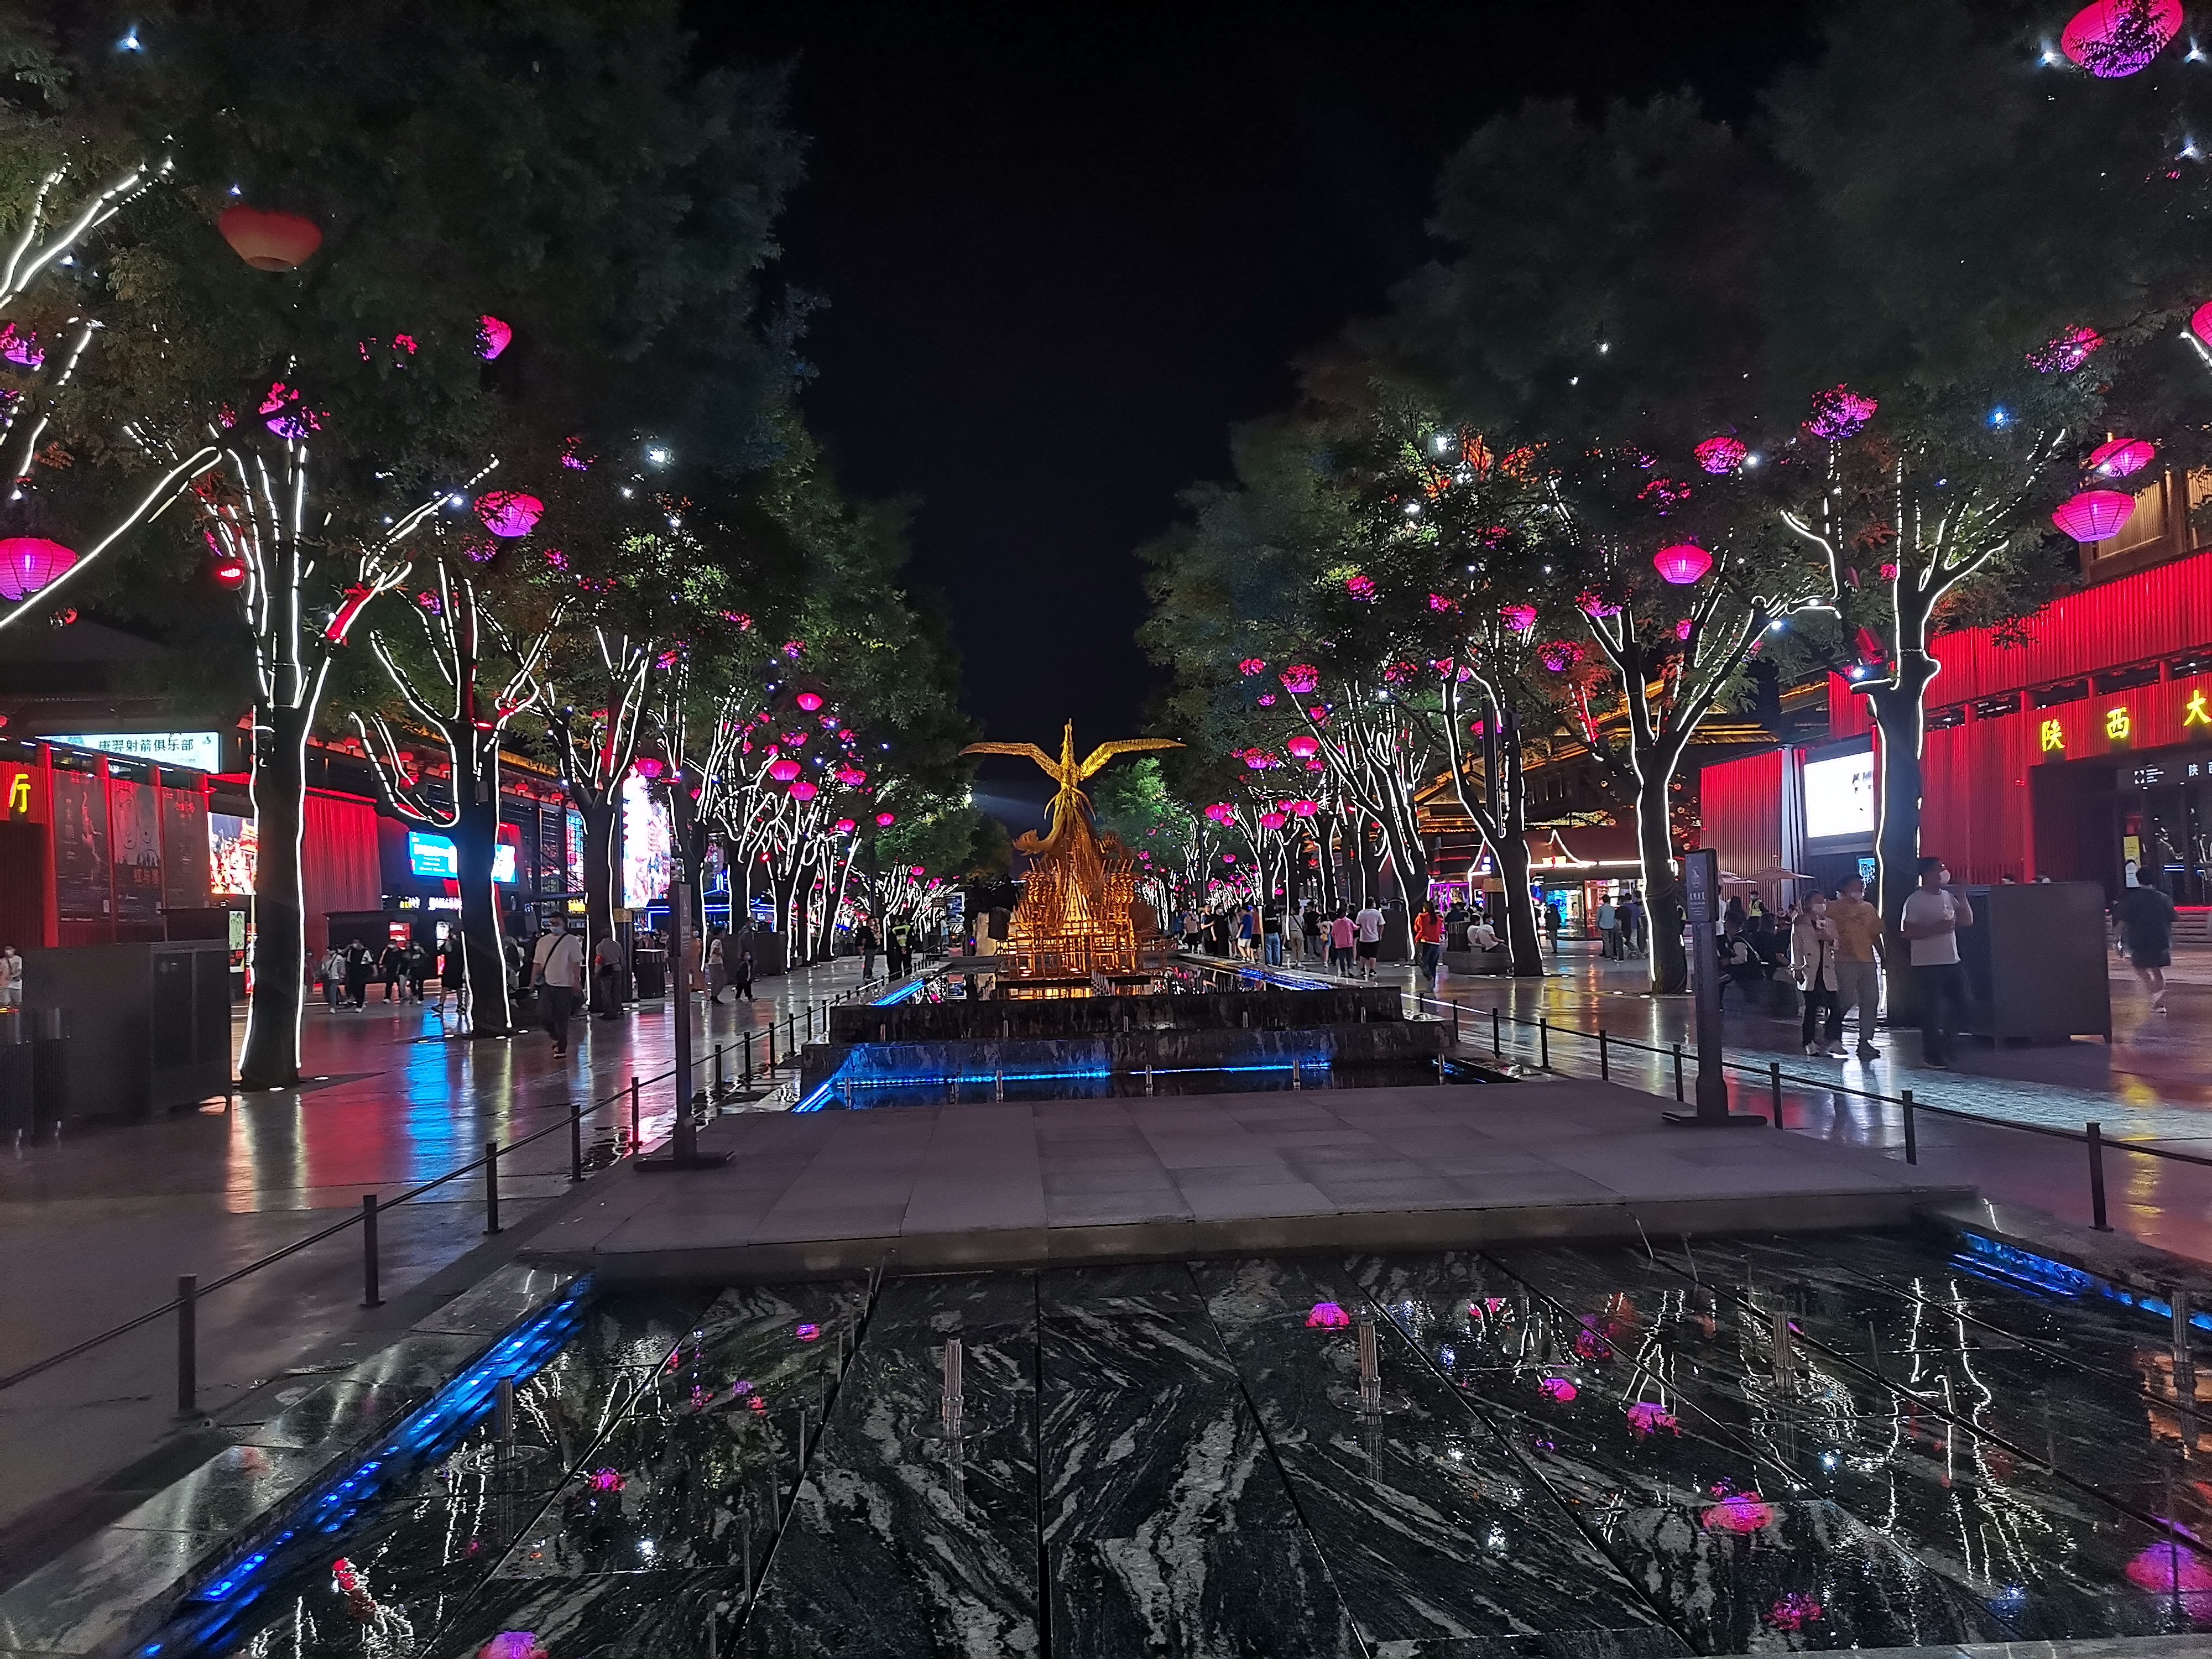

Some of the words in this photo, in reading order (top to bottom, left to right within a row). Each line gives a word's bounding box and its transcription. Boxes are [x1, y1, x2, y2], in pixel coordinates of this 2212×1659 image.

[99, 738, 194, 752] 唐羿射箭俱乐部
[9, 774, 31, 812] 厅
